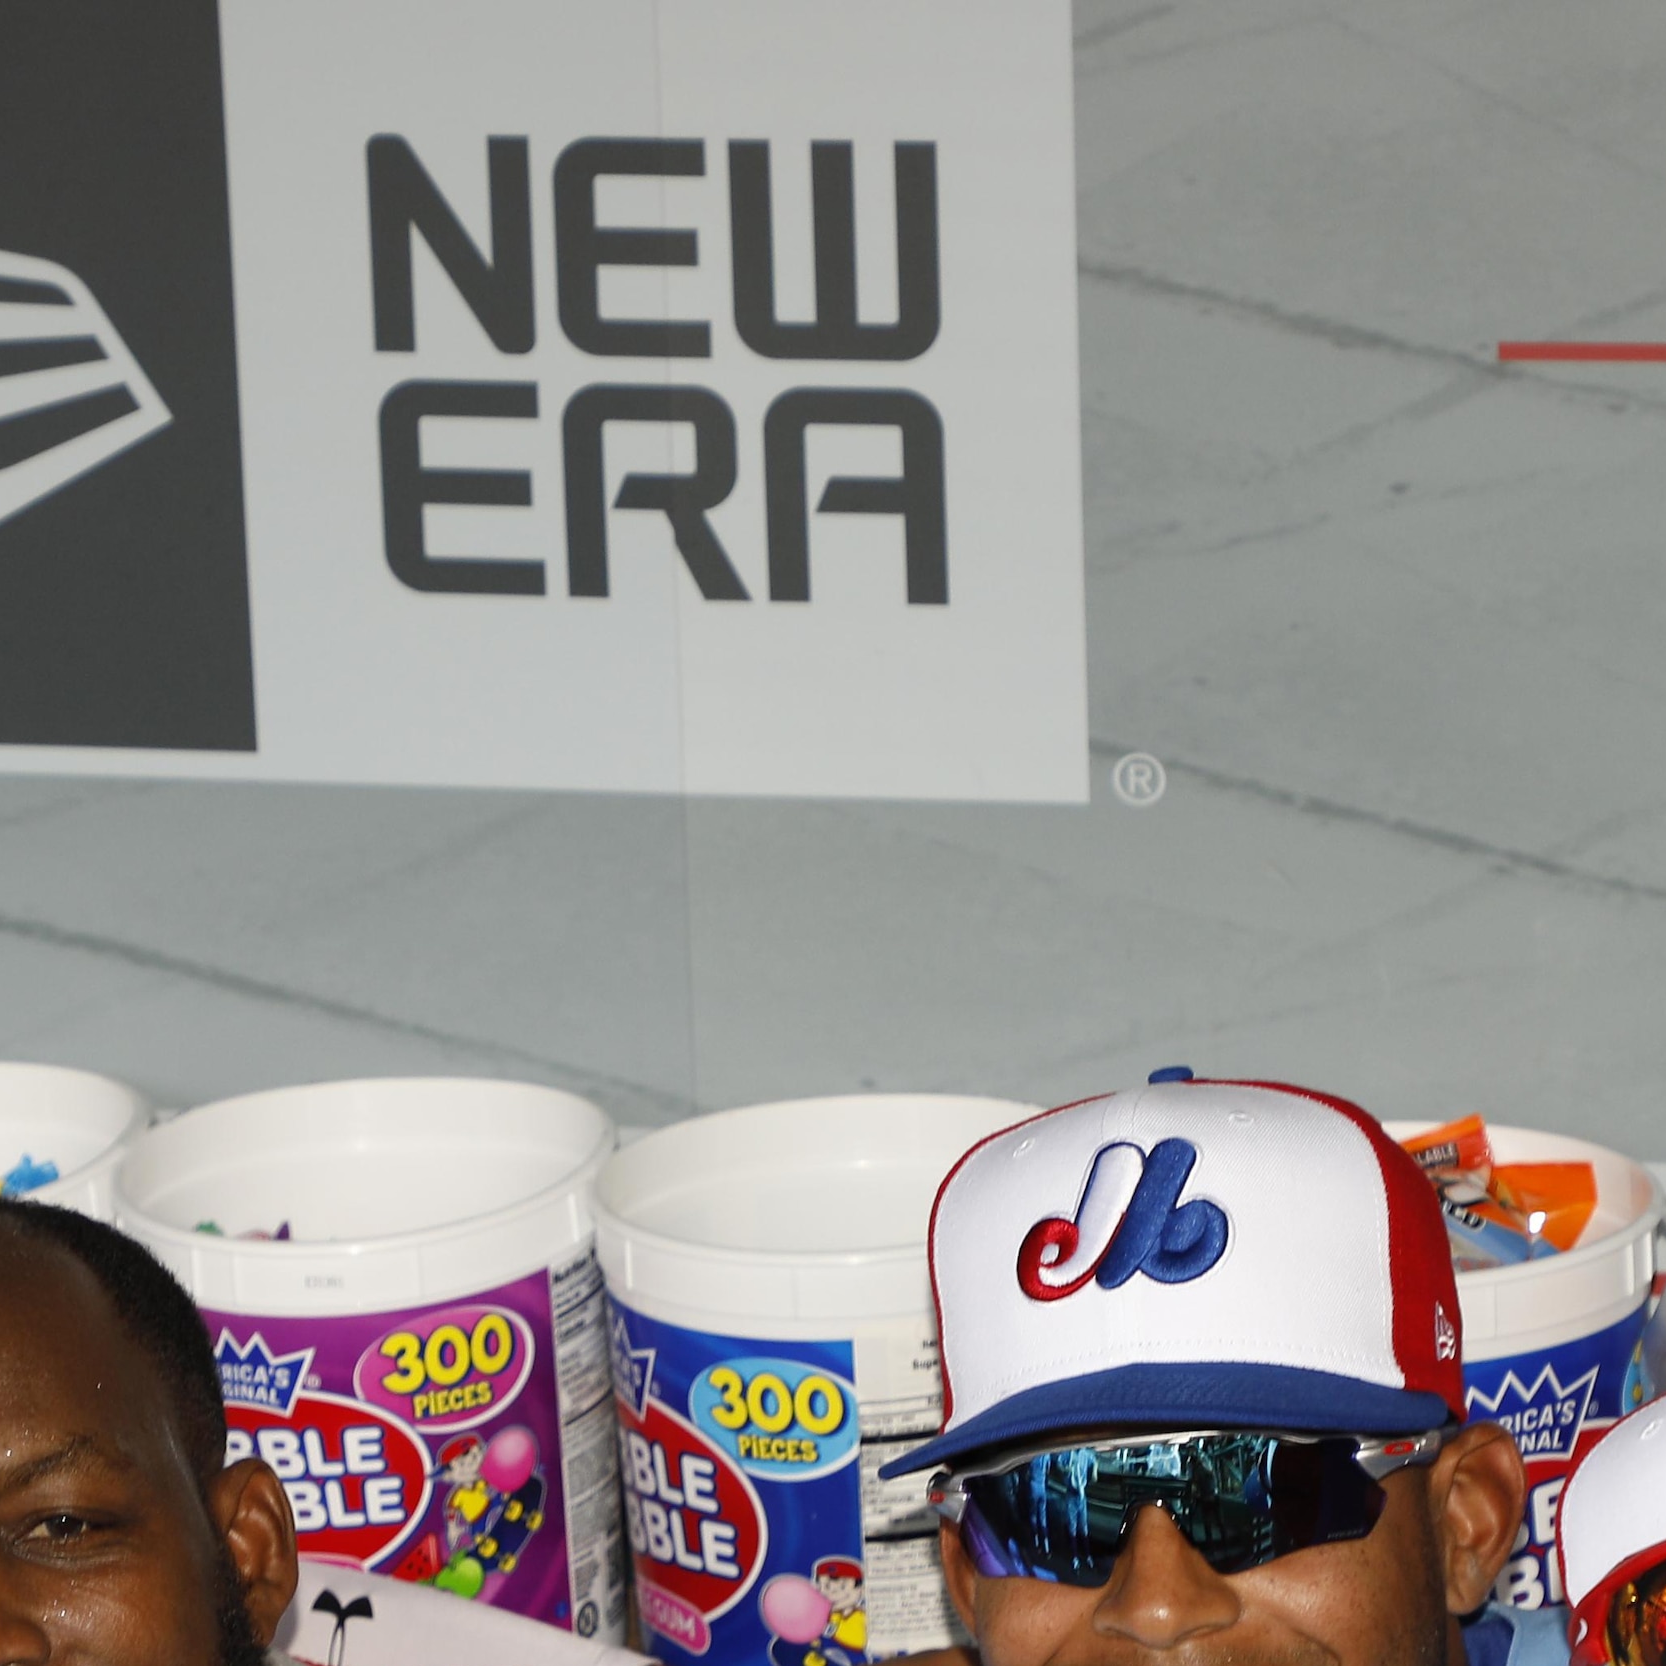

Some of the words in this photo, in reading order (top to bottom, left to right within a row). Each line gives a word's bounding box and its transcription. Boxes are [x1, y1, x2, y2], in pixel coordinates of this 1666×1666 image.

[365, 132, 942, 362] NEW
[376, 378, 950, 606] ERA
[378, 1312, 515, 1396] 300
[413, 1383, 493, 1420] PIECES
[707, 1364, 846, 1438] 300
[737, 1434, 820, 1464] PIECES
